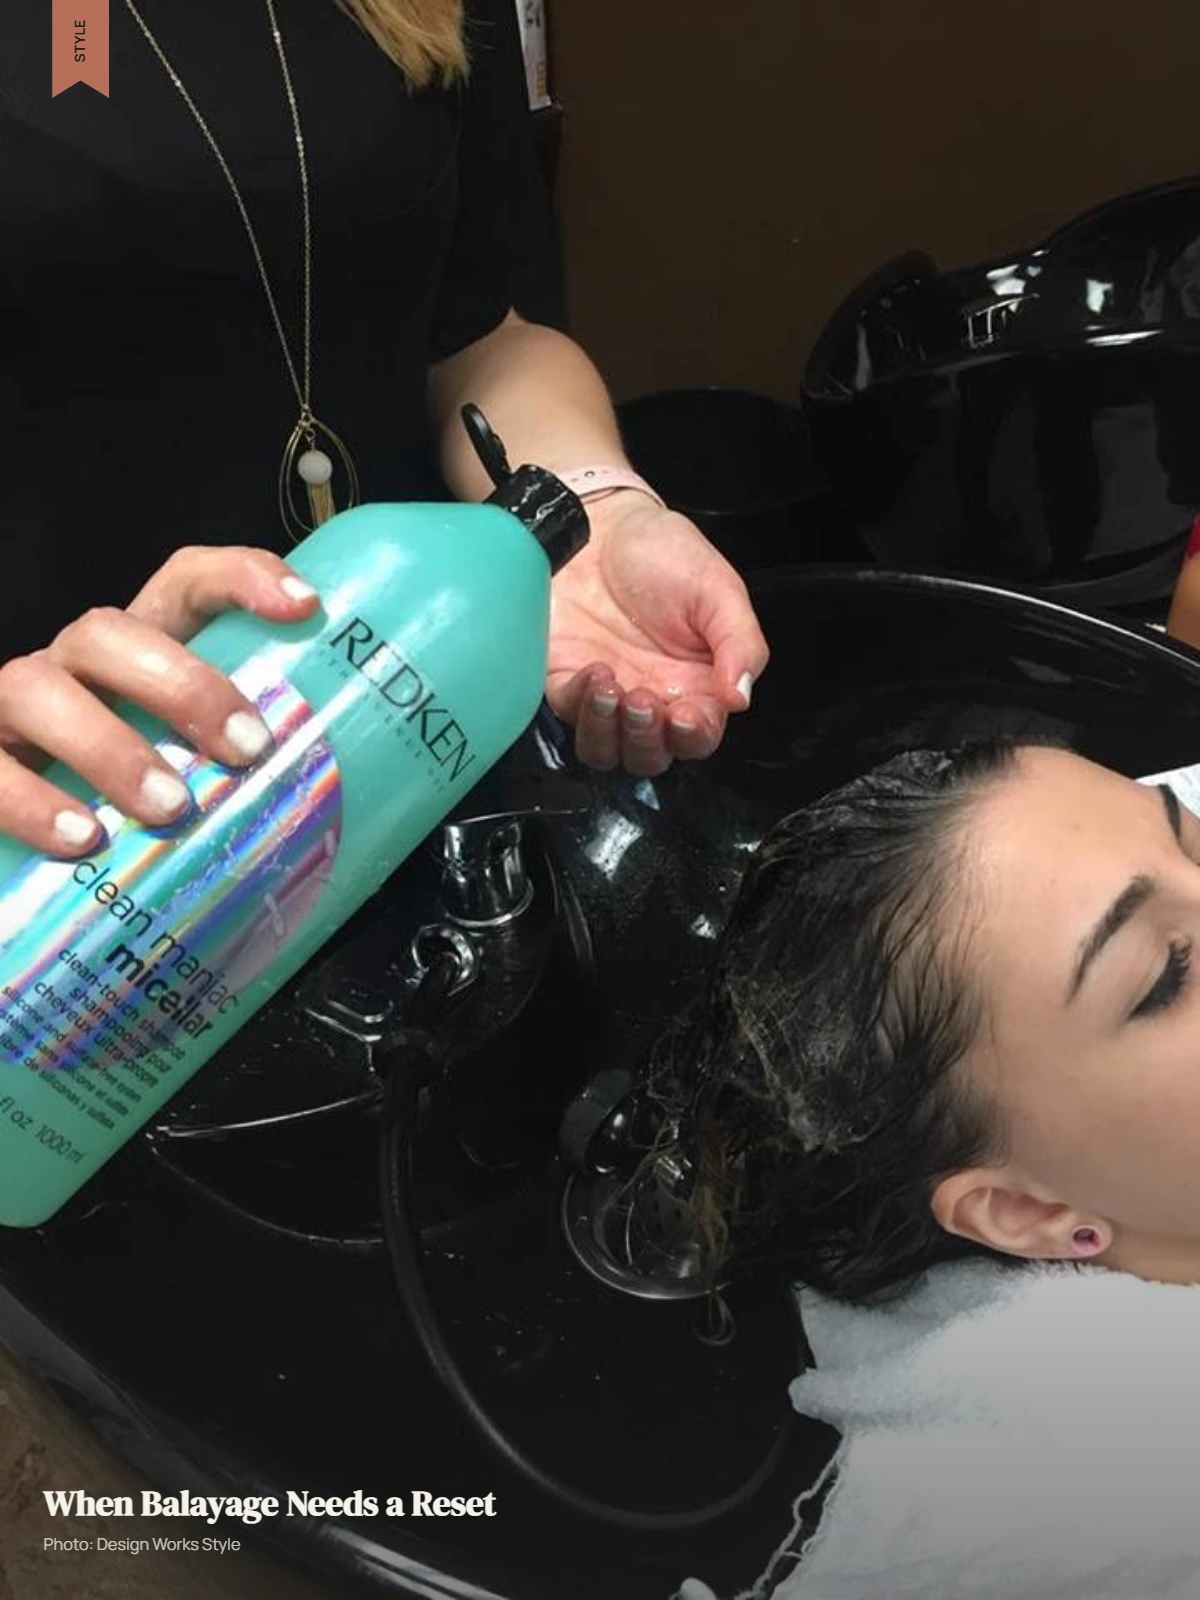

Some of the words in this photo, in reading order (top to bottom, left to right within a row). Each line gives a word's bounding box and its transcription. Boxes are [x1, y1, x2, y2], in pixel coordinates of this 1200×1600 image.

[329, 617, 476, 782] REDKEN
[73, 861, 152, 937] clean
[150, 932, 238, 1014] maniac
[34, 982, 94, 1034] cheveux
[58, 948, 139, 1021] clean-touch
[105, 943, 213, 1038] micellar
[11, 1109, 33, 1131] oz
